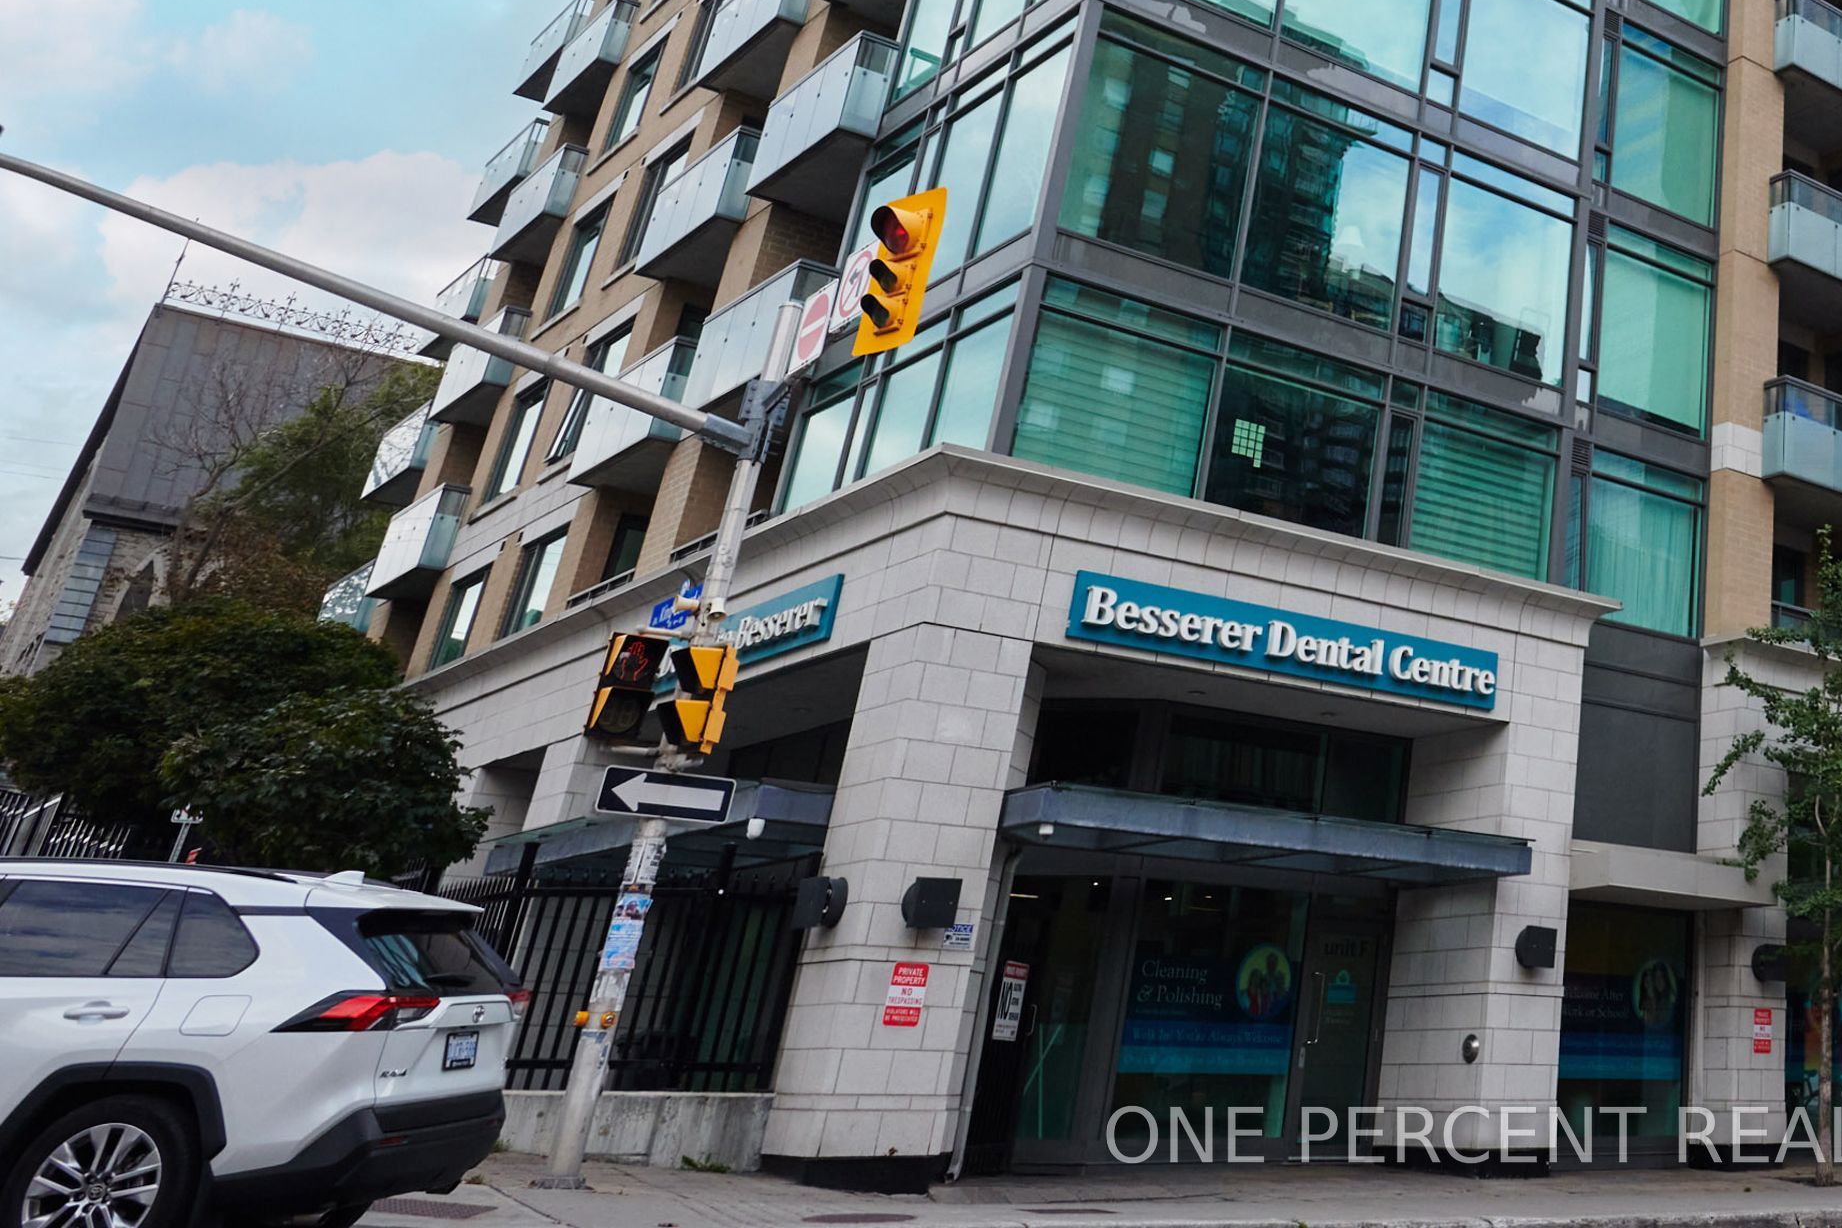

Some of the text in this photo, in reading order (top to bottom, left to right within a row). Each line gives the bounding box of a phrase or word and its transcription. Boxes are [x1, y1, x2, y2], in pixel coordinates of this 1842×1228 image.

[735, 597, 829, 649] Besserer
[1082, 585, 1496, 695] Besserer Dental Centre
[892, 975, 925, 985] PROPERTY
[898, 967, 924, 977] PRIVATE
[1142, 959, 1208, 984] Cleaning
[900, 987, 913, 996] NO
[1137, 984, 1224, 1010] & Polishing
